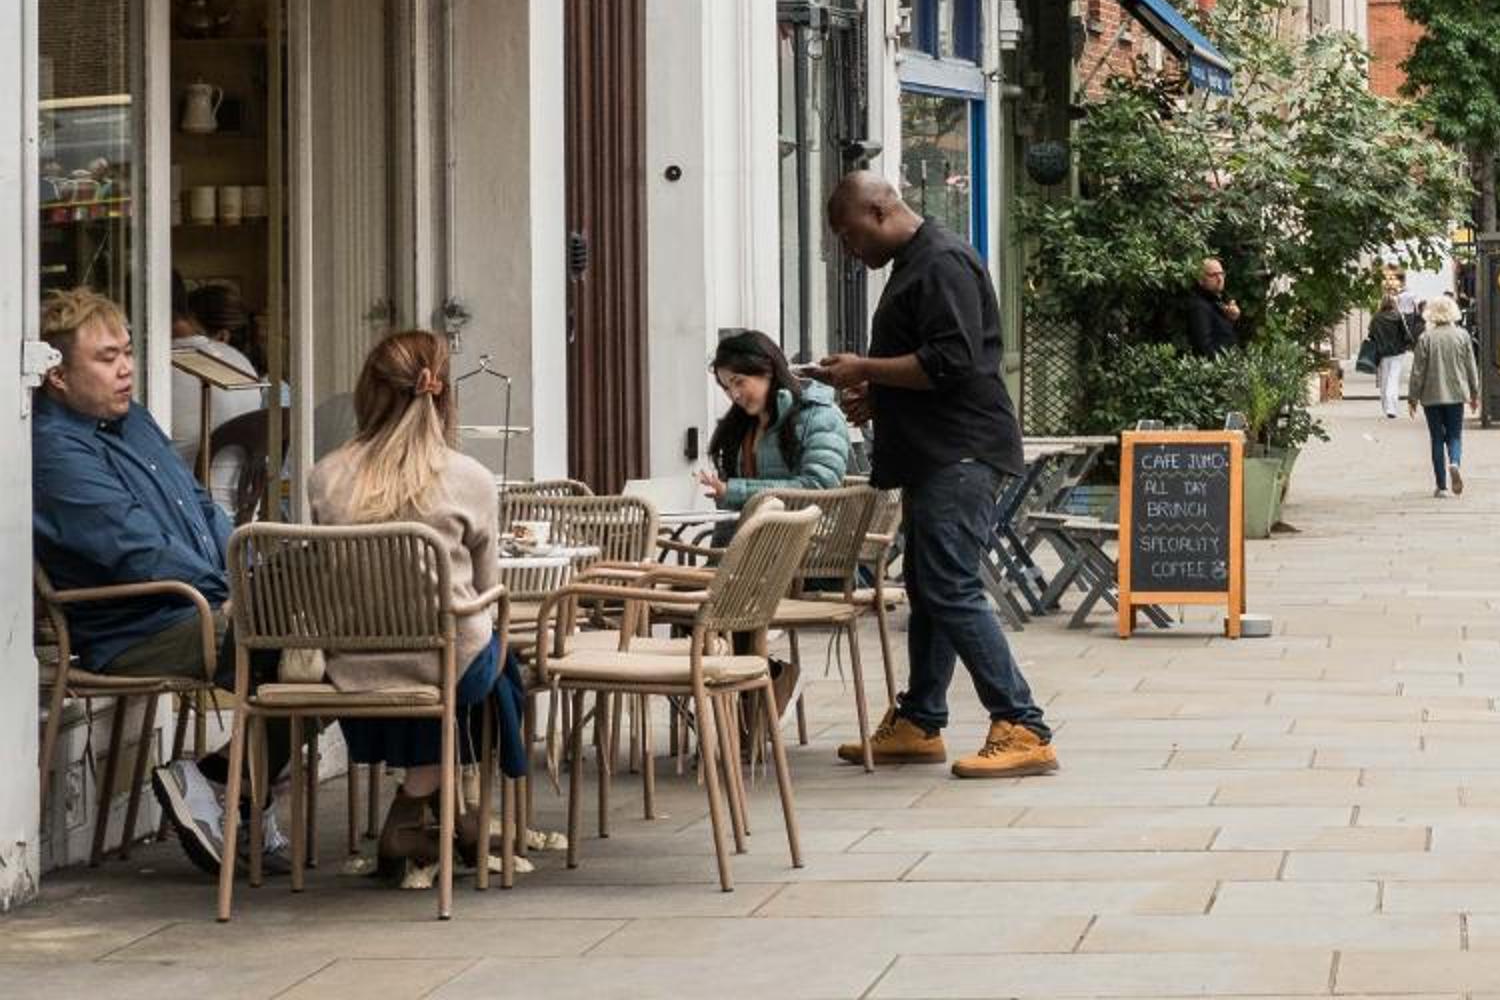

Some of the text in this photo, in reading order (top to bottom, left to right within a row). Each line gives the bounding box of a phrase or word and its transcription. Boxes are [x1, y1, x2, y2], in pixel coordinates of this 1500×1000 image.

[1141, 453, 1181, 470] CAFE
[1144, 480, 1208, 496] ALL DAY
[1147, 501, 1208, 518] BRUNCH
[1151, 561, 1207, 578] COFFEE
